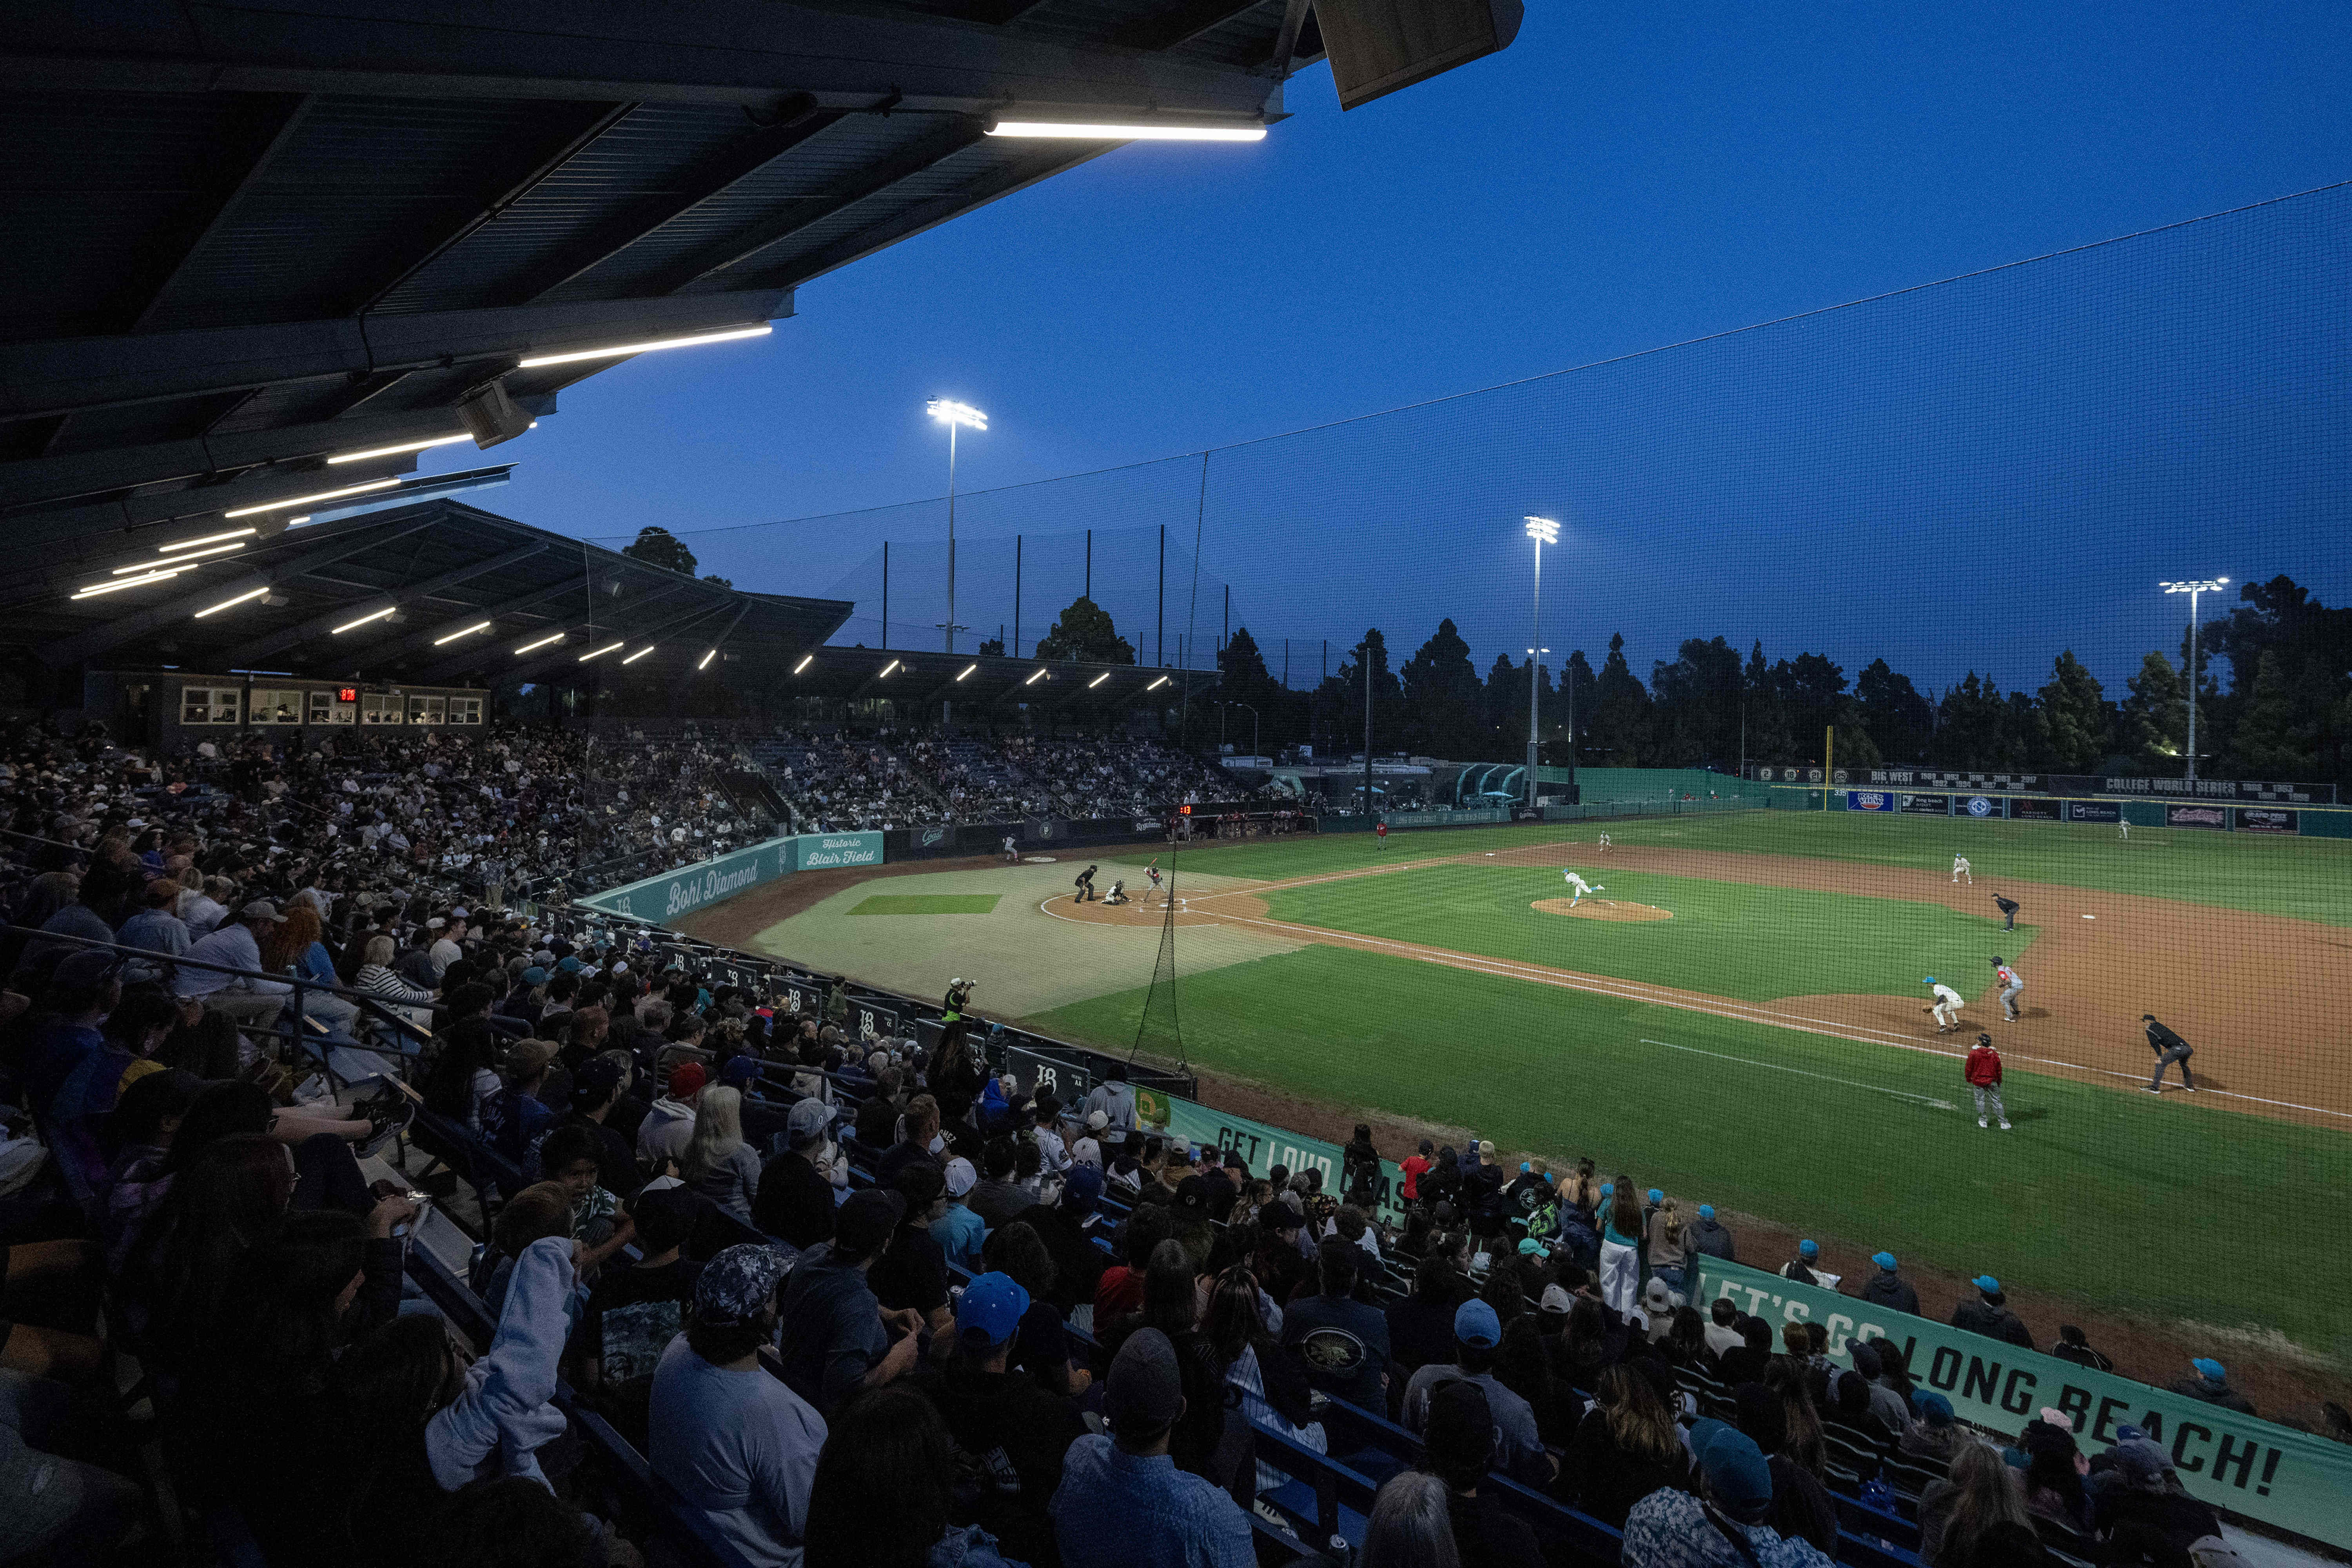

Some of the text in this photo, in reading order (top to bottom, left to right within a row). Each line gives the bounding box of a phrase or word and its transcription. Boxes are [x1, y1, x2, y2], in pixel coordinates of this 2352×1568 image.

[1871, 771, 1913, 782] BIG WEST
[2106, 778, 2150, 789] COLLEGE
[2153, 779, 2193, 792] WORLD
[2196, 781, 2236, 794] SERIES
[822, 838, 861, 849] Historic
[922, 829, 944, 843] Coast
[806, 850, 875, 866] Blair Field
[666, 858, 758, 916] Bohl Diamond
[1218, 1126, 1261, 1165] GET
[1903, 1336, 2282, 1497] LONG BEACH!
